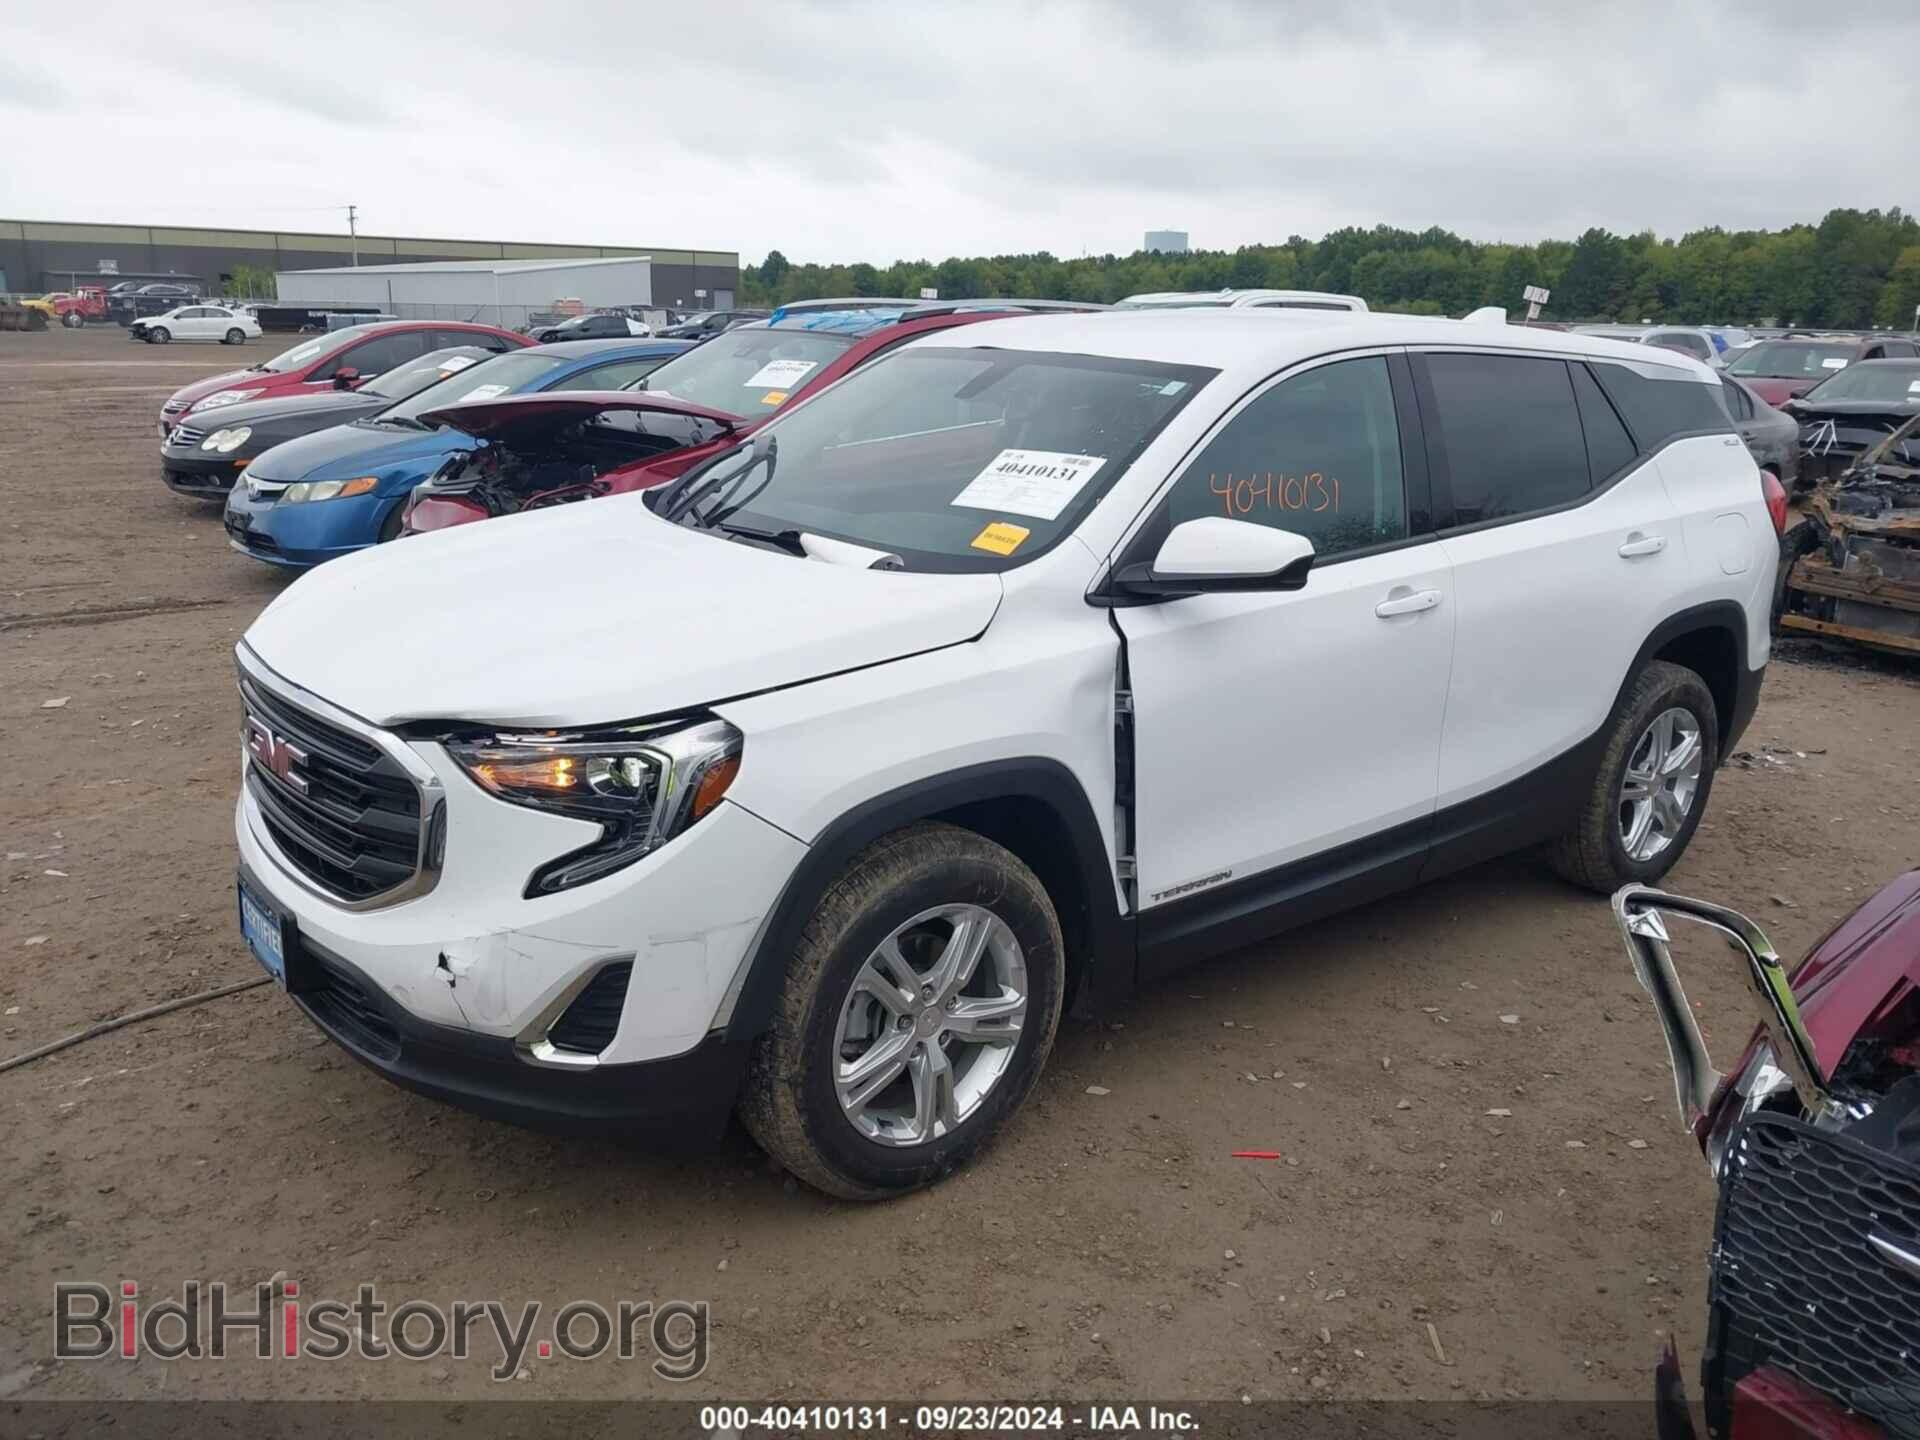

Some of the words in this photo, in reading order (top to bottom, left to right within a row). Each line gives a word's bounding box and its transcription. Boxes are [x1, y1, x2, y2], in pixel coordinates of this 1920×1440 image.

[996, 462, 1078, 481] 40410131
[1210, 472, 1339, 517] 40410131
[247, 714, 309, 795] GMC
[1151, 869, 1233, 902] TERRAIN
